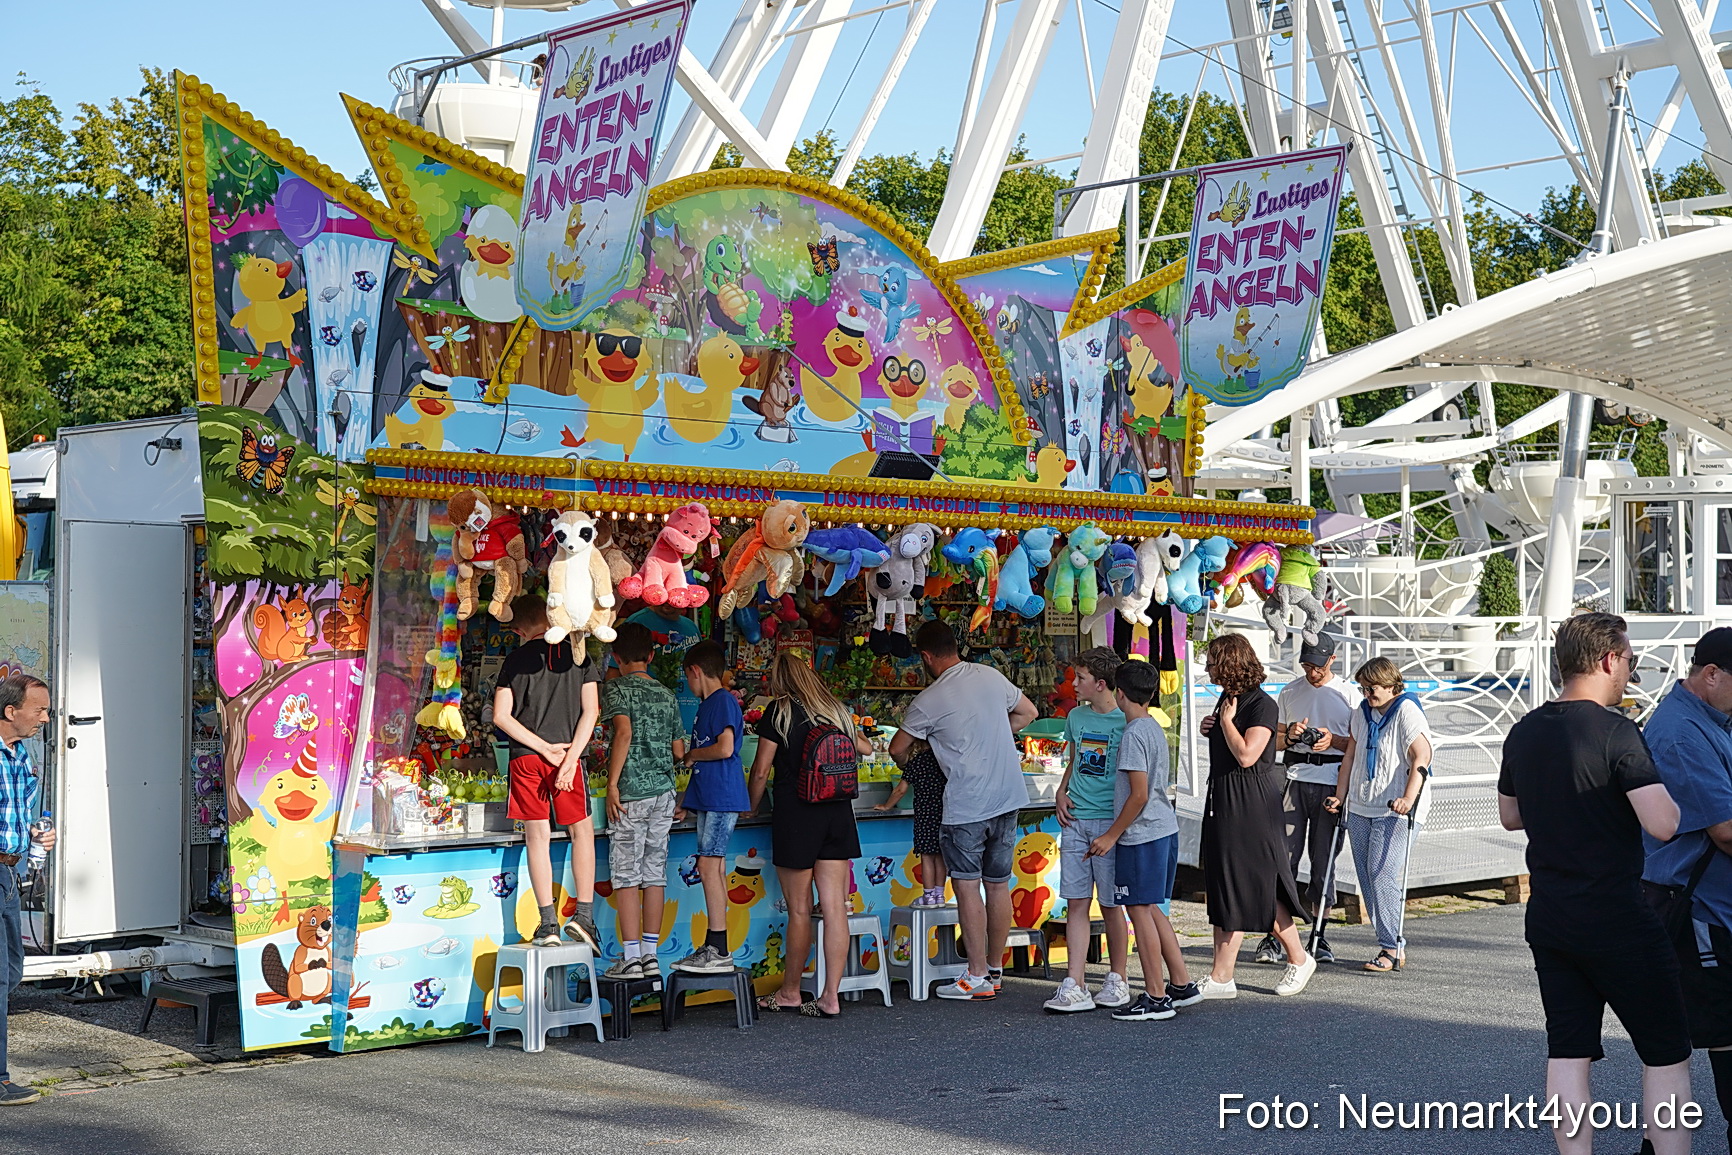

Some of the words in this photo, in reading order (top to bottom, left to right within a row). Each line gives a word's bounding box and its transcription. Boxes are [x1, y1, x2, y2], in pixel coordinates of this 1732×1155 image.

[594, 35, 672, 94] Lustiges
[537, 83, 654, 165] ENTEN-
[521, 137, 654, 232] ANGELN
[1252, 177, 1330, 220] Lustiges
[1196, 215, 1317, 275] ENTEN-
[1184, 259, 1322, 326] ANGELN
[404, 465, 469, 486] LUSTIGE
[473, 469, 546, 491] ANGELEI
[593, 477, 642, 498] VIEL
[823, 490, 900, 510] LUSTIGE
[905, 494, 981, 515] ANGELEI
[1017, 501, 1134, 522] ENTENANGELN
[1179, 511, 1212, 527] VIEL
